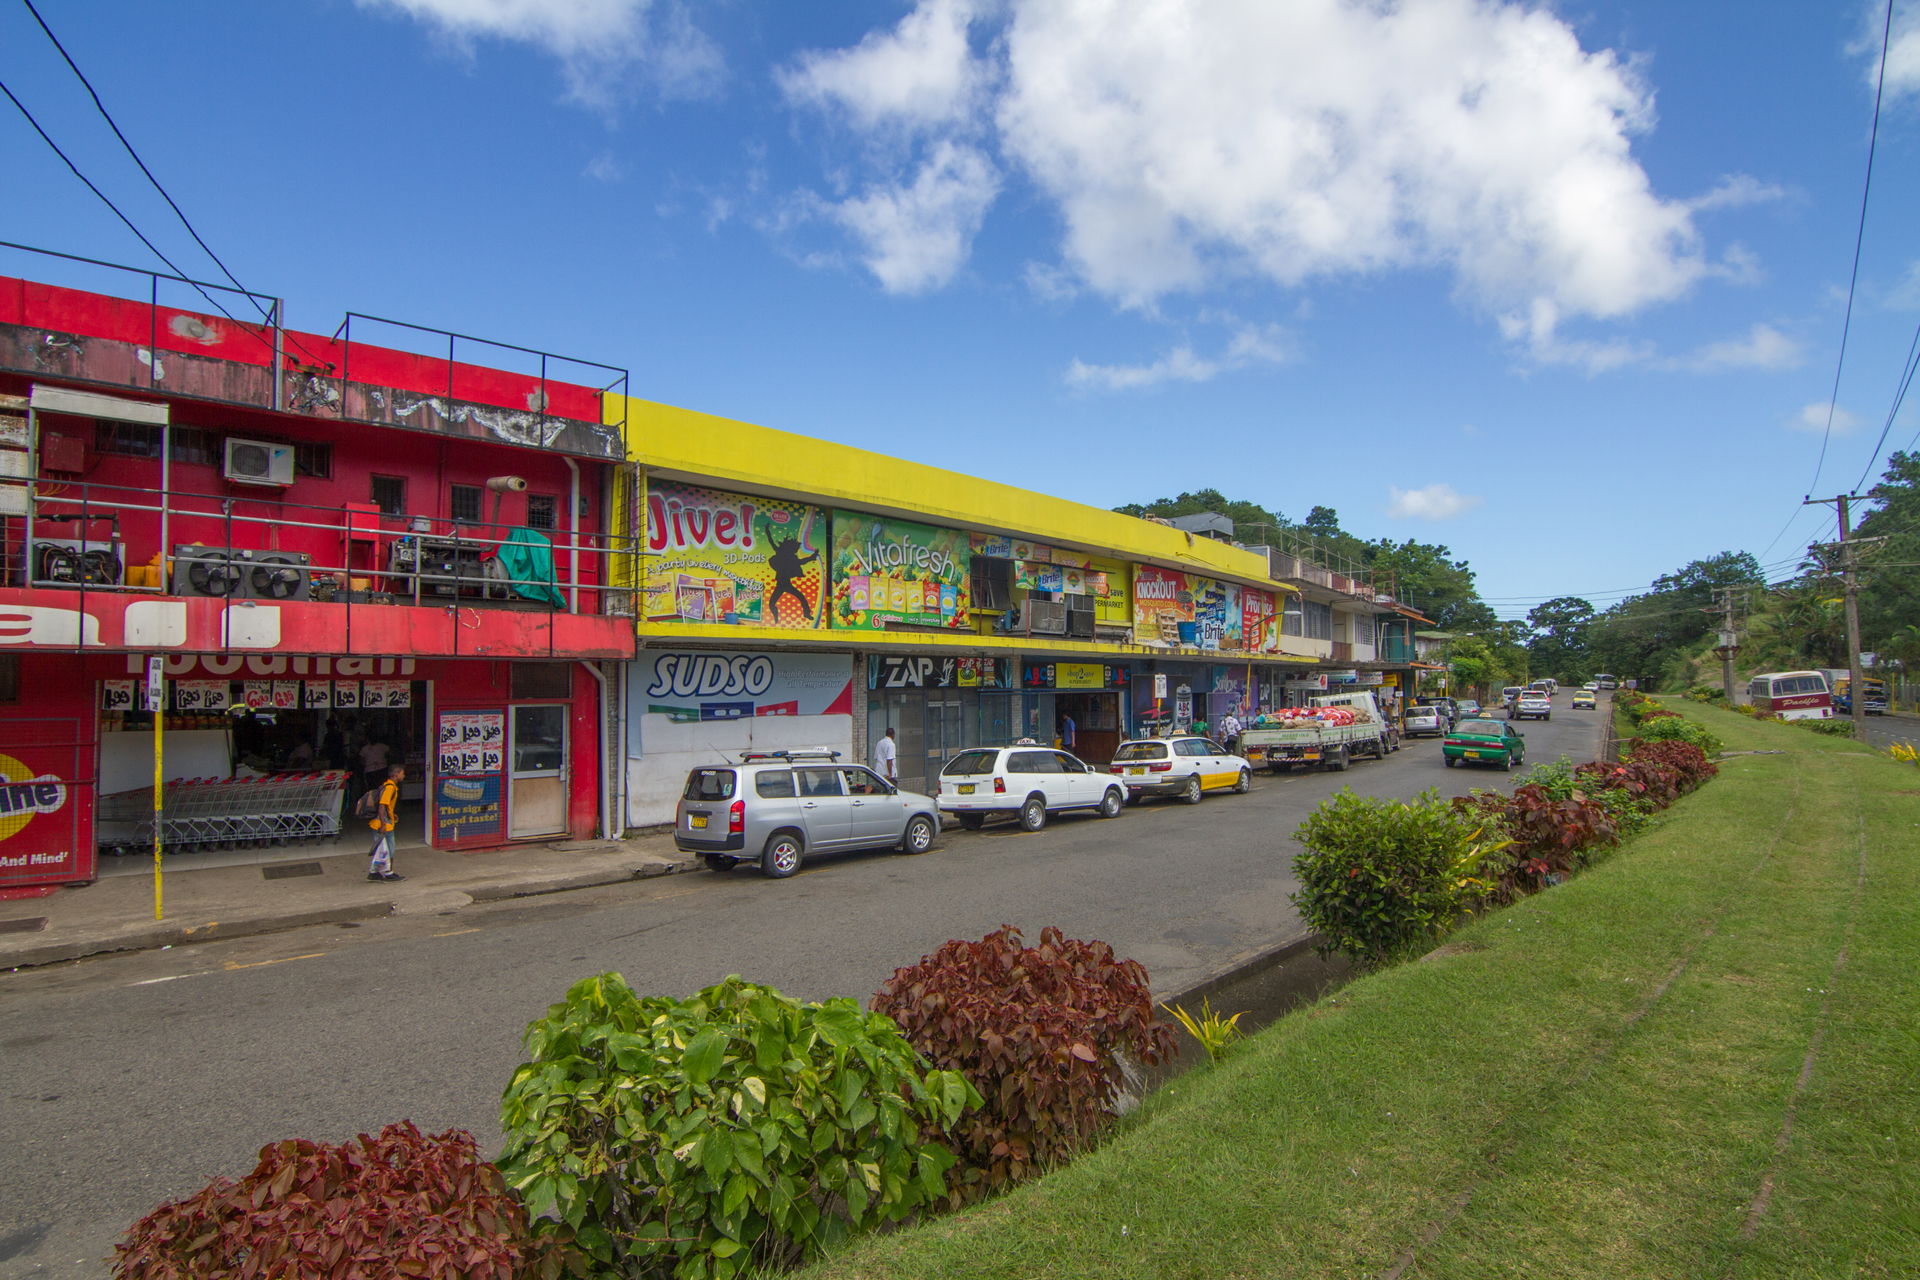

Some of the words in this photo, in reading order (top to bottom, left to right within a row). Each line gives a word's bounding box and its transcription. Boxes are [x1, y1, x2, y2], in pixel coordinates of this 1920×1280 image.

[648, 493, 755, 551] Jive!
[723, 552, 766, 564] 3D-Pods
[854, 534, 955, 582] Vitafresh
[1041, 573, 1061, 585] Brite
[1110, 587, 1124, 598] save
[1136, 581, 1178, 599] KNOCKOUT
[1094, 599, 1124, 609] PERMARKET
[872, 612, 881, 628] 6
[1204, 622, 1225, 641] Brite
[647, 653, 774, 698] SUDSO
[885, 657, 934, 687] ZAP
[1024, 667, 1047, 681] ABC
[1112, 668, 1131, 682] ABC
[1782, 698, 1819, 706] Pacific
[440, 806, 460, 816] The
[440, 816, 466, 829] good
[469, 813, 498, 824] taste!
[0, 854, 27, 867] And
